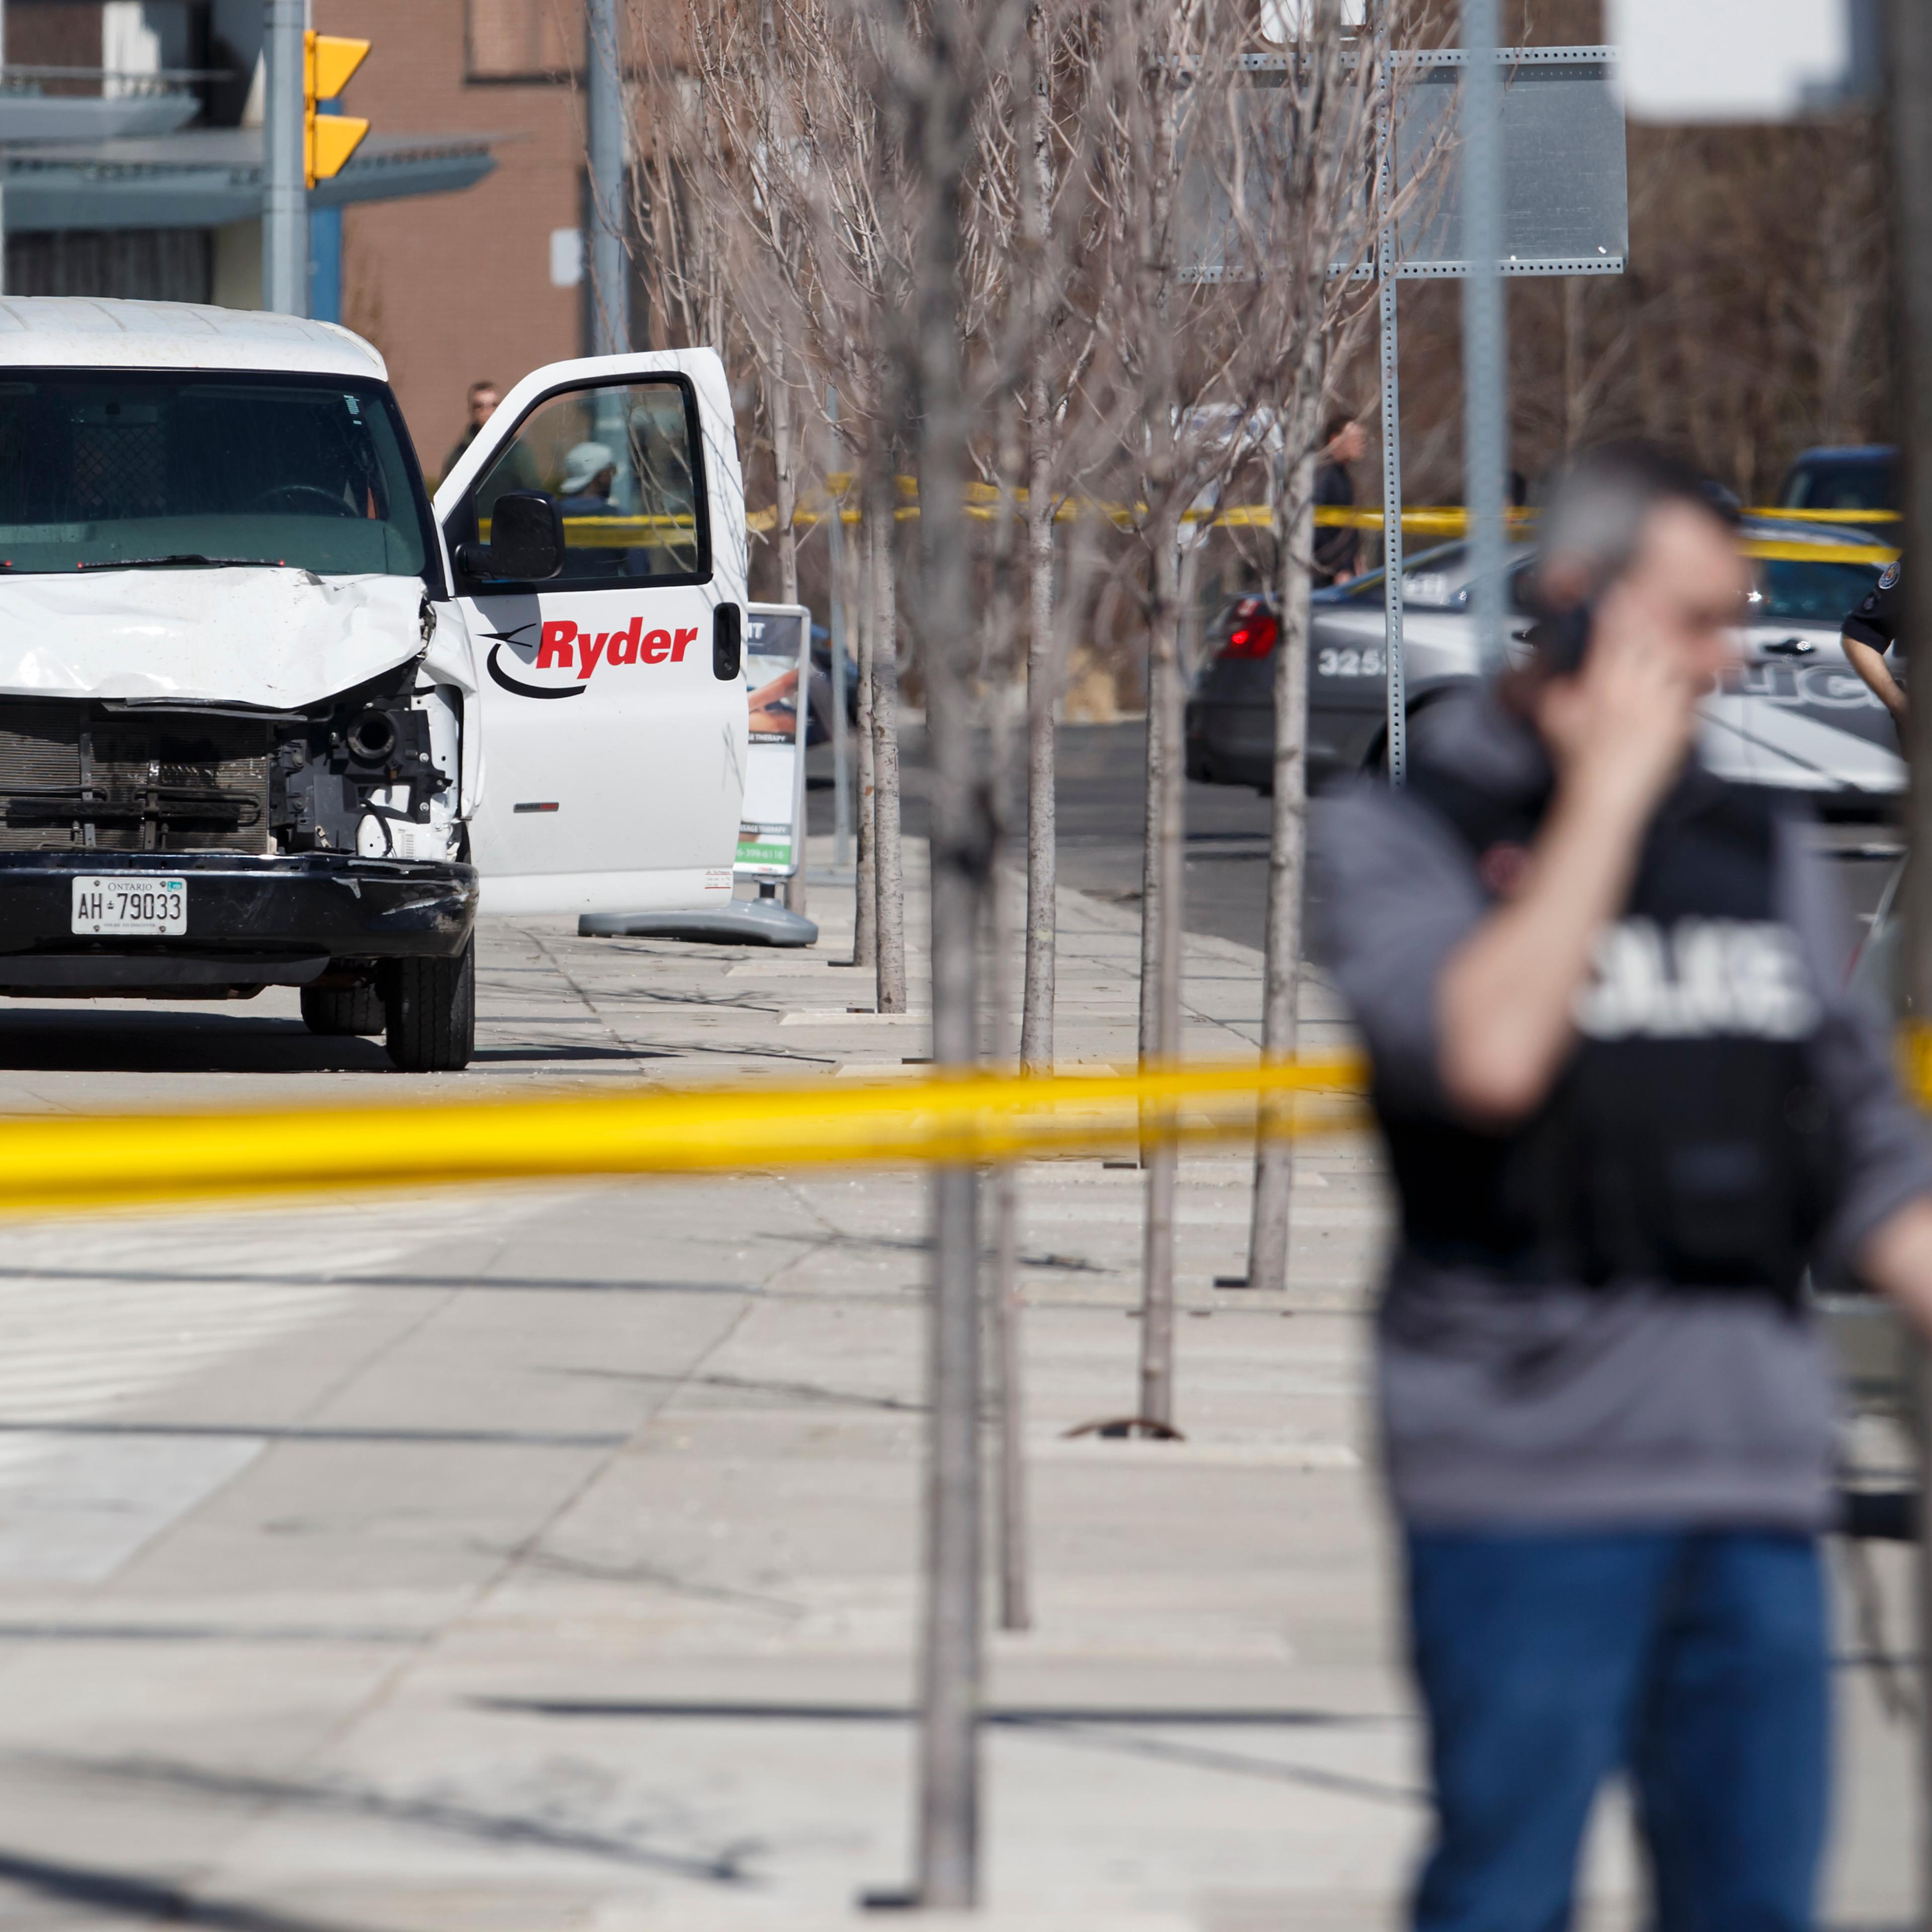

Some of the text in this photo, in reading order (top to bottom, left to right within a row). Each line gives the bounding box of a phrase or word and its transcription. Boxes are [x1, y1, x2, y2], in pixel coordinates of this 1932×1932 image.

[536, 617, 698, 679] Ryder
[1318, 648, 1387, 676] 325
[755, 734, 785, 742] THERAPY
[108, 882, 152, 891] ONTARIO
[78, 893, 181, 920] AH 79033
